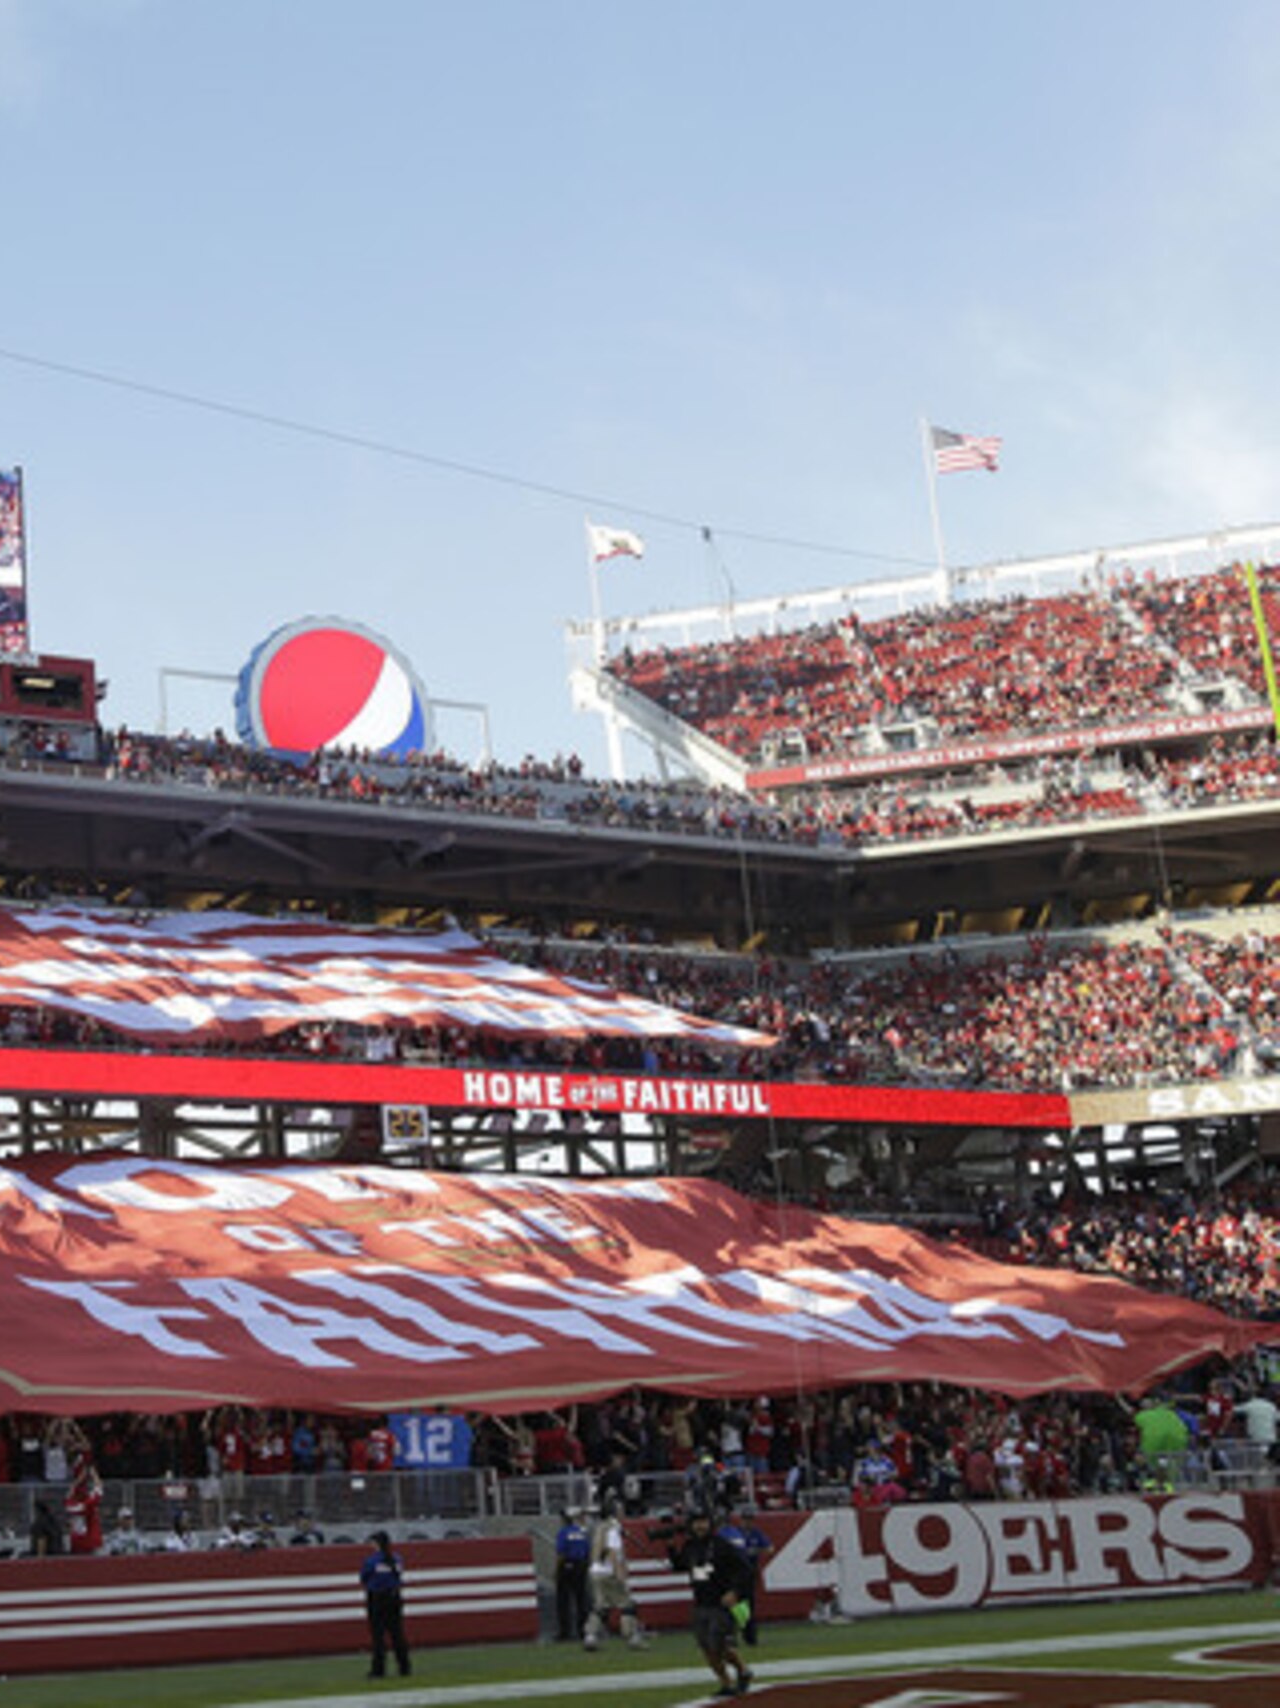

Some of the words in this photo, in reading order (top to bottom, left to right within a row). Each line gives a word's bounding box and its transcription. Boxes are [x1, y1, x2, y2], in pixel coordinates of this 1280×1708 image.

[463, 1072, 564, 1105] HOME
[623, 1080, 770, 1113] FAITHFUL
[403, 1417, 453, 1463] 12
[761, 1494, 1255, 1620] 49ERS
